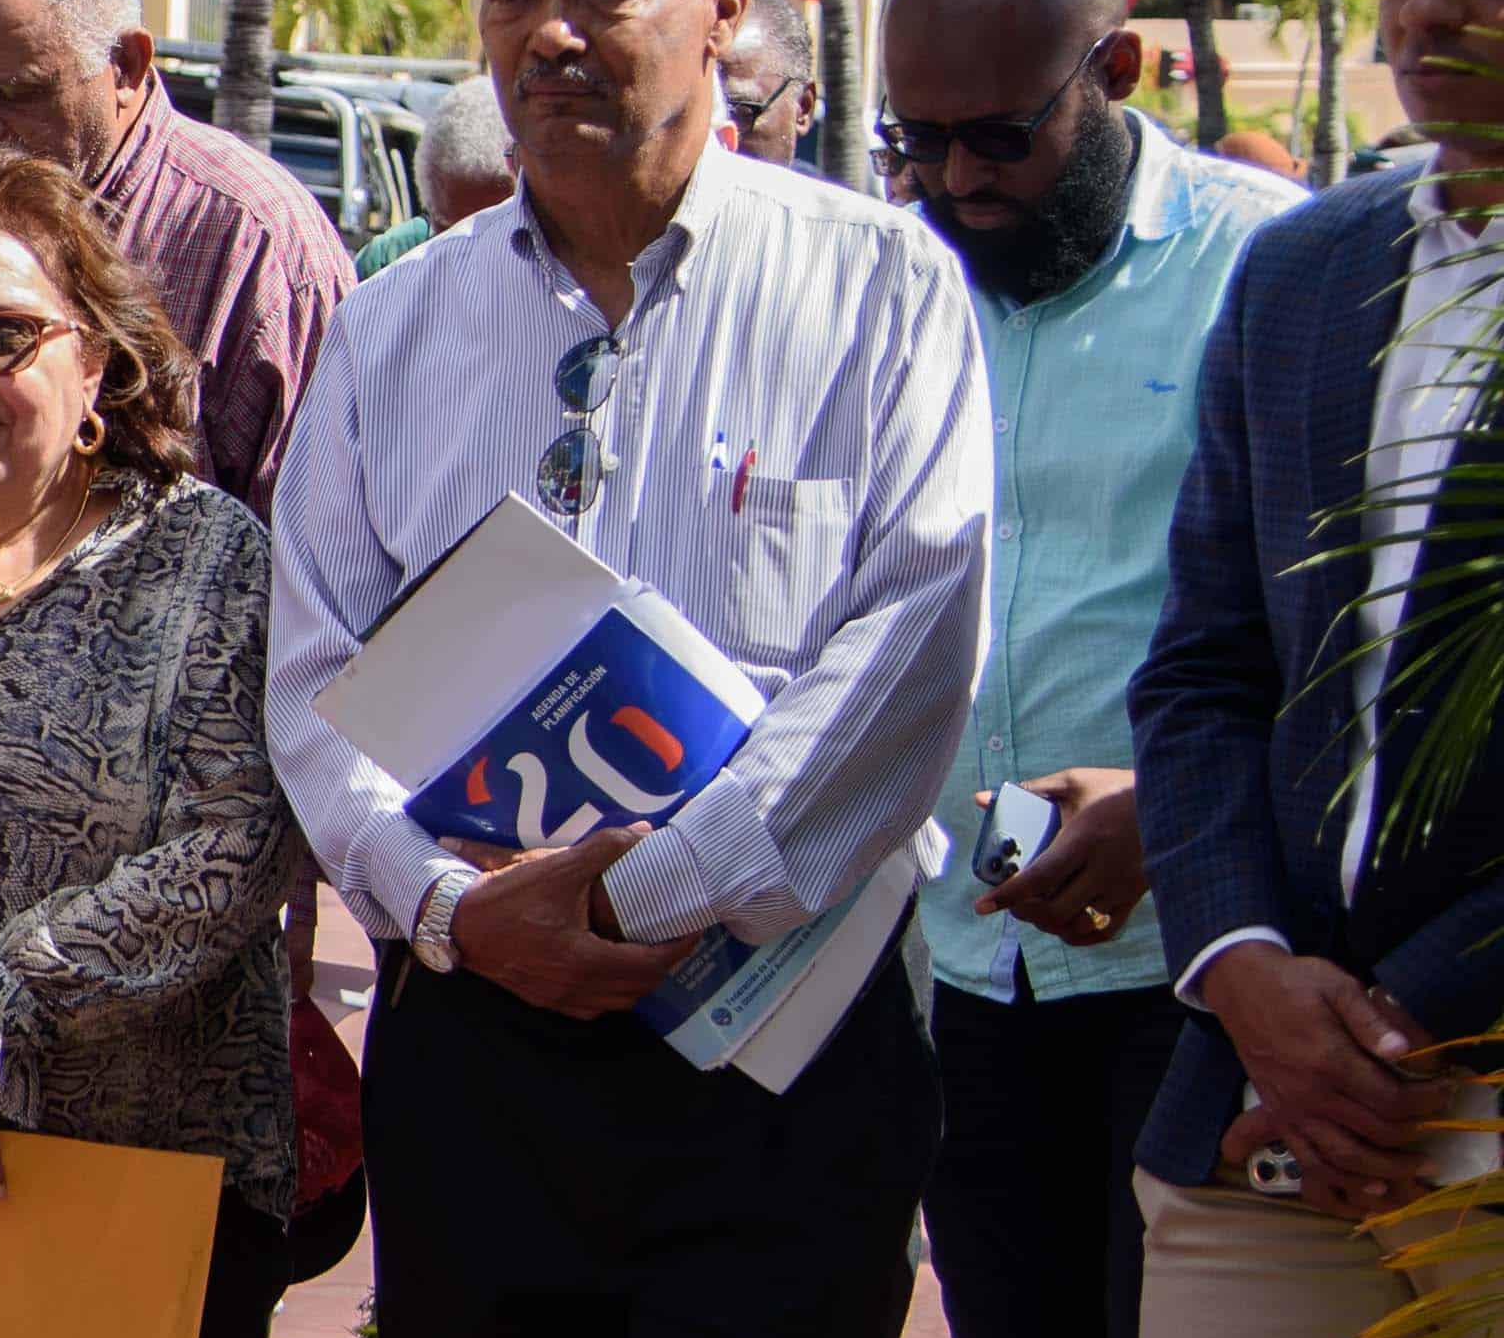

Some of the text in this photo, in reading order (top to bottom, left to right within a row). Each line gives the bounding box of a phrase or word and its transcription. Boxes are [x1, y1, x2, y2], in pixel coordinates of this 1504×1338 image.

[531, 669, 582, 723] AGENDA DE
[541, 664, 608, 731] PLANIFICACIÓN
